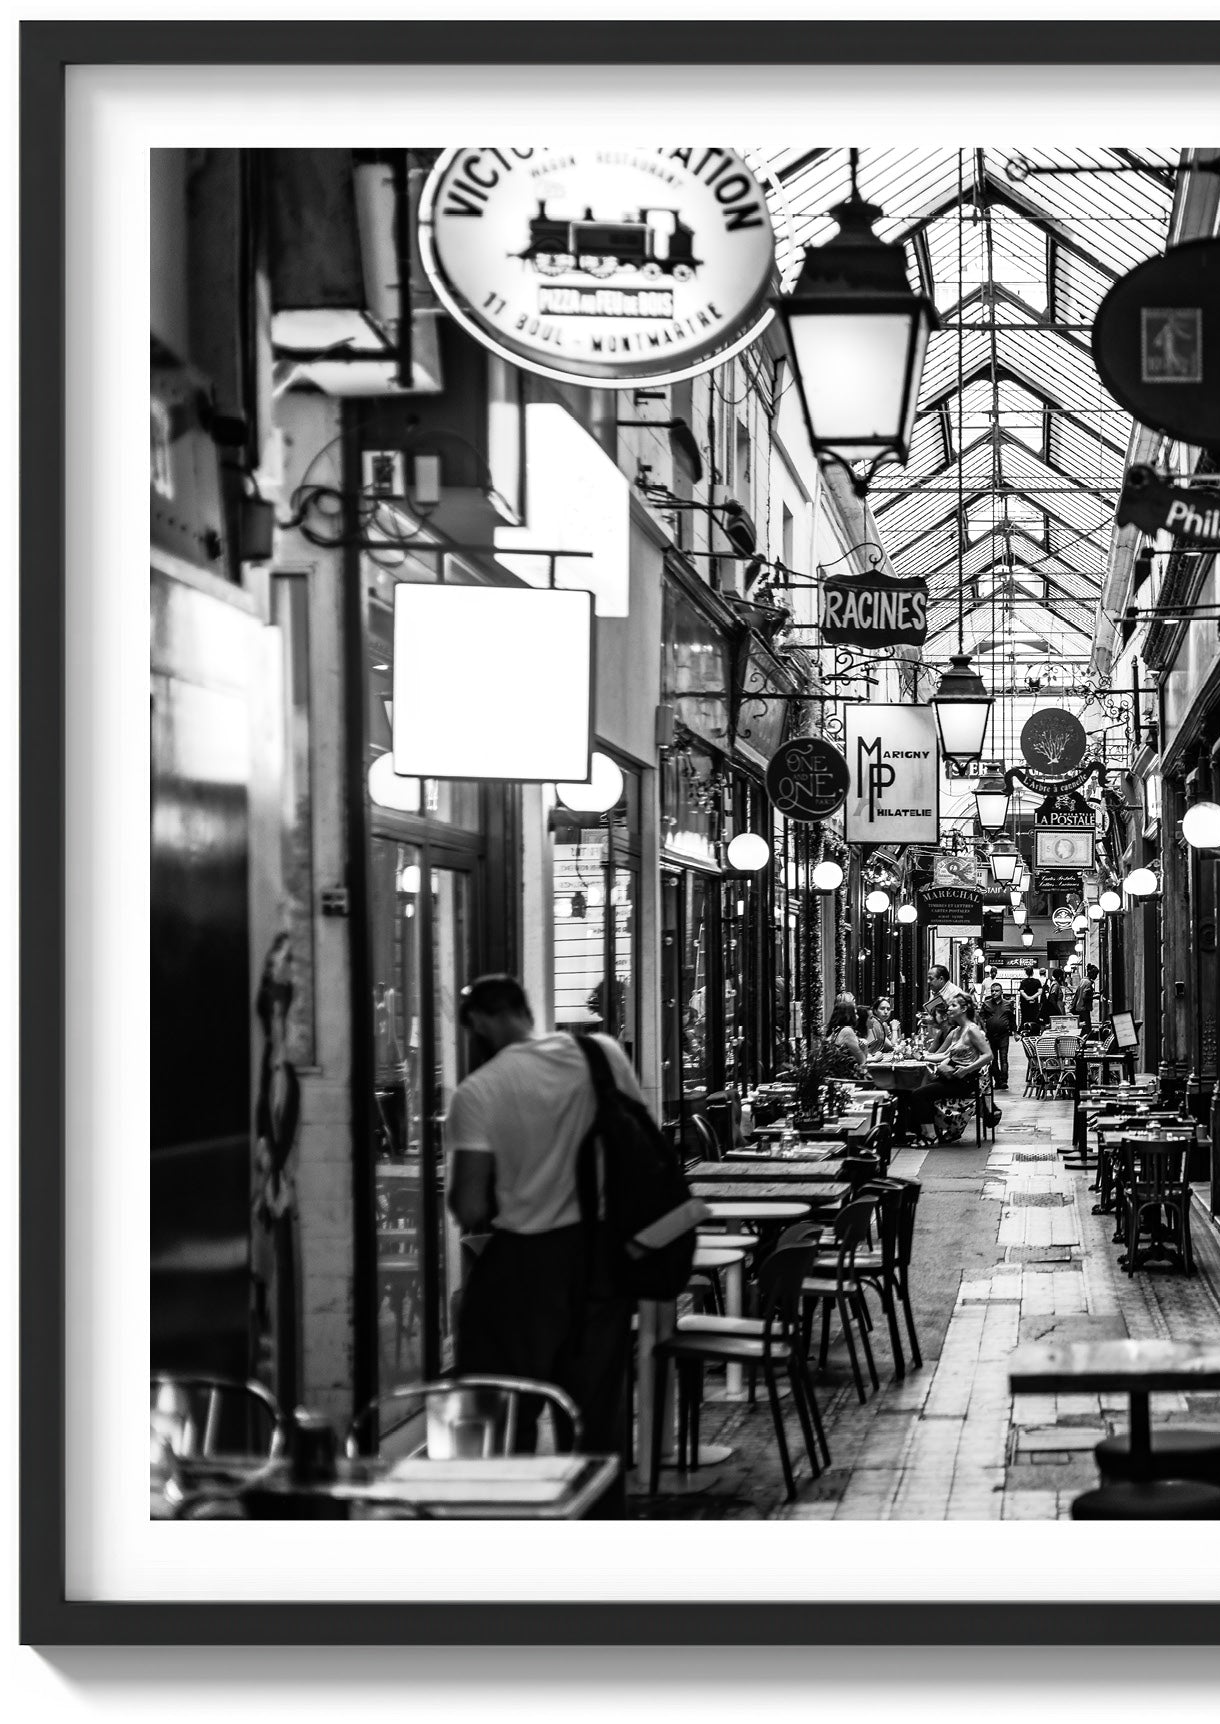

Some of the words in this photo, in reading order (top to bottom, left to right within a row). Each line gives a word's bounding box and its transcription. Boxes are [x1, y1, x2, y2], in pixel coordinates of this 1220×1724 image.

[658, 148, 763, 232] ATION
[825, 590, 926, 631] RACINES
[785, 744, 828, 772] ONE
[1023, 776, 1051, 792] L'Arbre
[1053, 784, 1058, 793] à
[1060, 774, 1087, 792] cannelle
[1034, 812, 1048, 824] LA
[1050, 812, 1095, 824] POSTALE
[923, 888, 980, 903] MARÉCHAL
